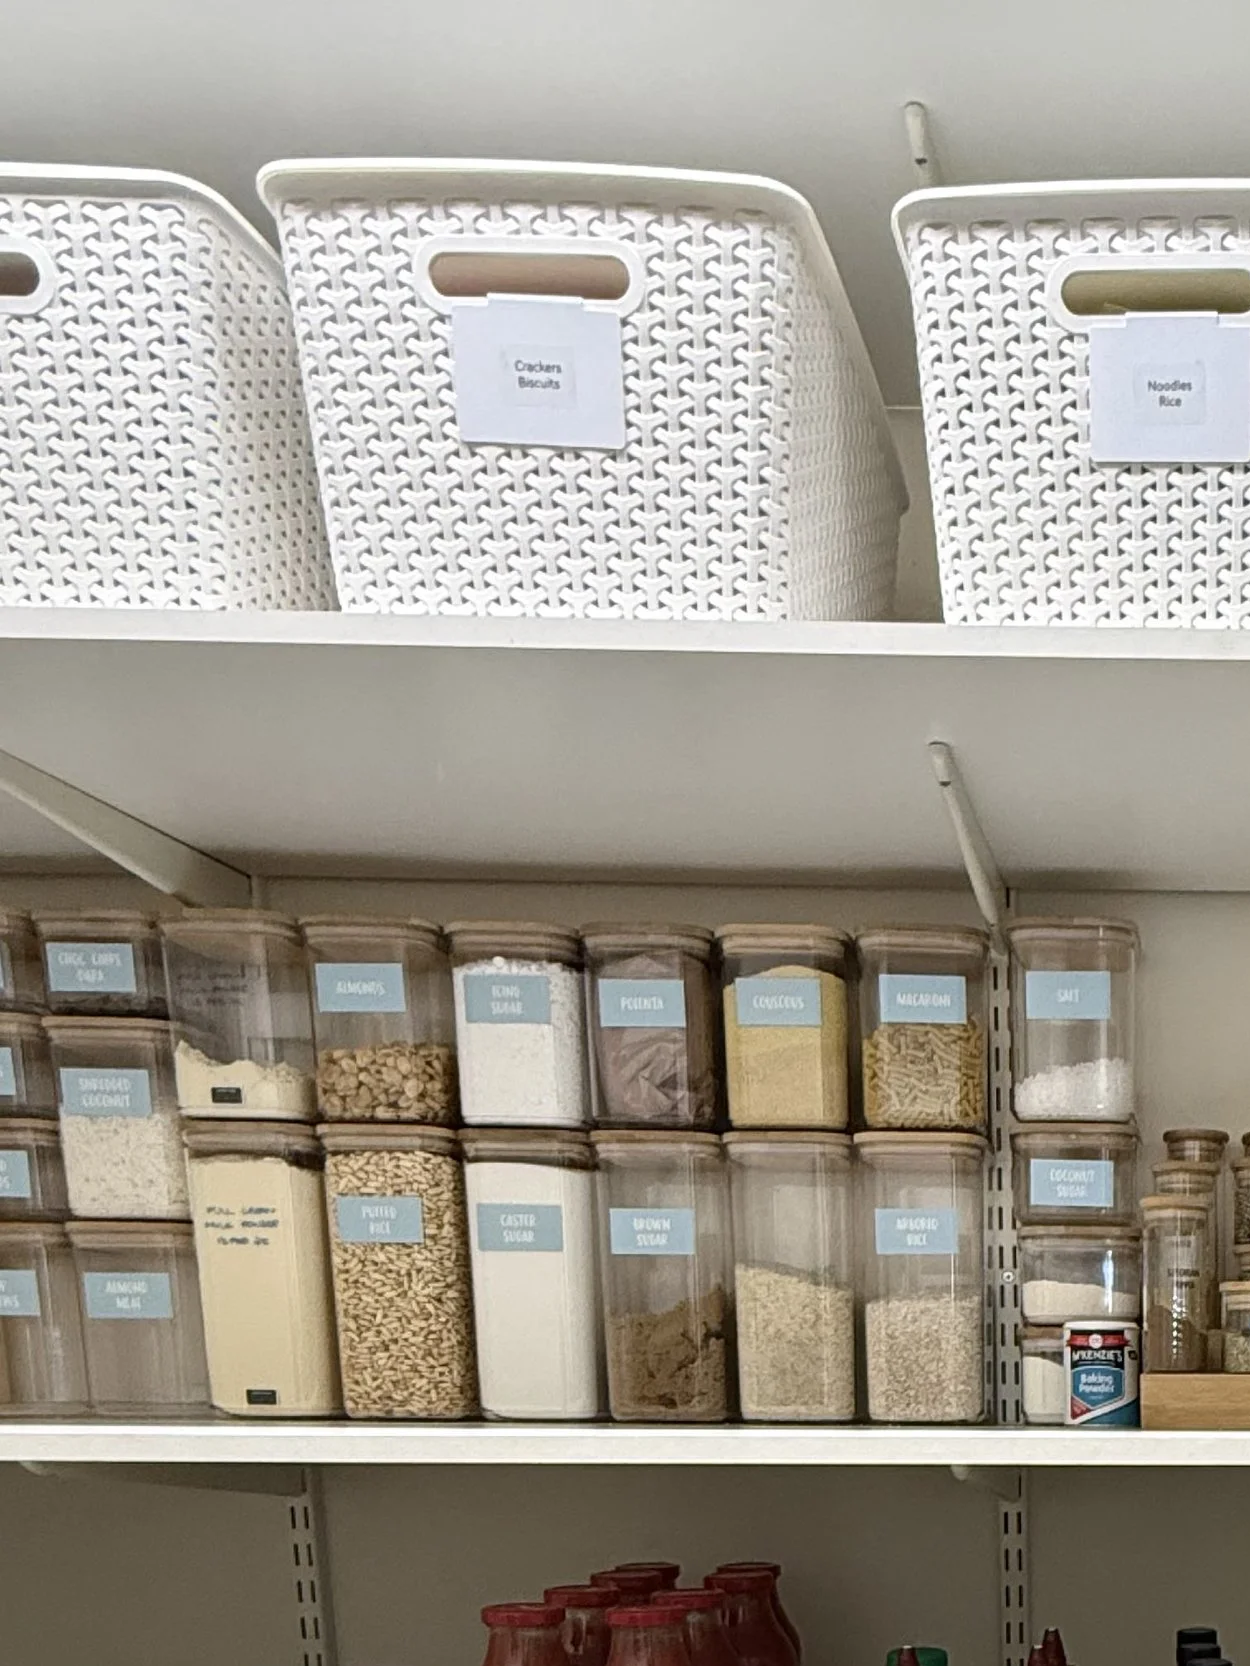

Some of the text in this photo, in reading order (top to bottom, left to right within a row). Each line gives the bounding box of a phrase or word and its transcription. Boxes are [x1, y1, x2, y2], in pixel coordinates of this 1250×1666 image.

[514, 359, 562, 374] Crackers
[518, 376, 561, 390] Biscuits
[1147, 379, 1192, 392] Noodles
[1158, 395, 1182, 408] Rice
[752, 995, 805, 1011] COUSCOUS
[1057, 988, 1081, 1003] SALT
[500, 1213, 537, 1228] CASTER
[633, 1217, 672, 1232] BROWN
[502, 1229, 536, 1244] SUGAR
[636, 1232, 669, 1247] SUGAR
[1080, 1372, 1114, 1385] Baking
[1078, 1383, 1115, 1394] Powder
